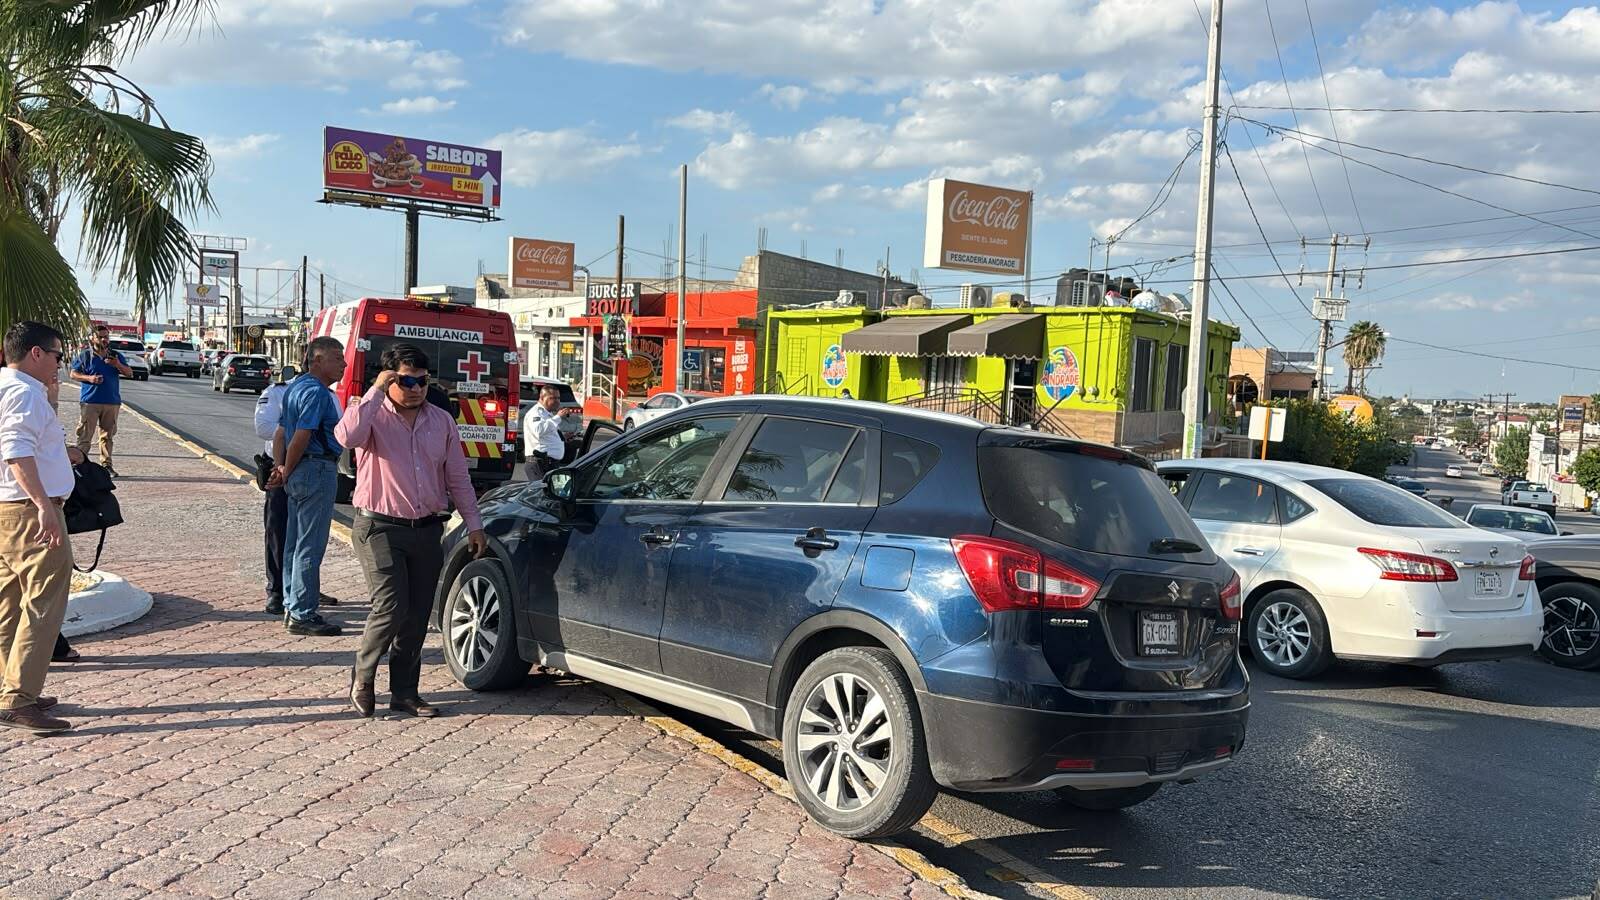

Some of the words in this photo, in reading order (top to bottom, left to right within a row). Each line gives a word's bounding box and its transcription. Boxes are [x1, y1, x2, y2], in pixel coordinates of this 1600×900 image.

[334, 151, 363, 161] POLLO
[426, 145, 488, 168] SABOR
[335, 160, 363, 170] LOCO
[430, 163, 467, 174] IRRESISTIBLE
[457, 180, 463, 189] 5
[463, 181, 480, 191] MIN
[949, 190, 1024, 231] Coca-Cola
[516, 242, 569, 265] Coca-Cola
[988, 256, 1016, 268] ANDRADE
[588, 283, 635, 299] BURGER
[588, 298, 635, 316] BOWL
[398, 326, 480, 343] AMBULANCIA
[1040, 373, 1080, 387] ANDRADE
[461, 432, 497, 441] COAH-097B
[1050, 618, 1089, 628] SUZUKI
